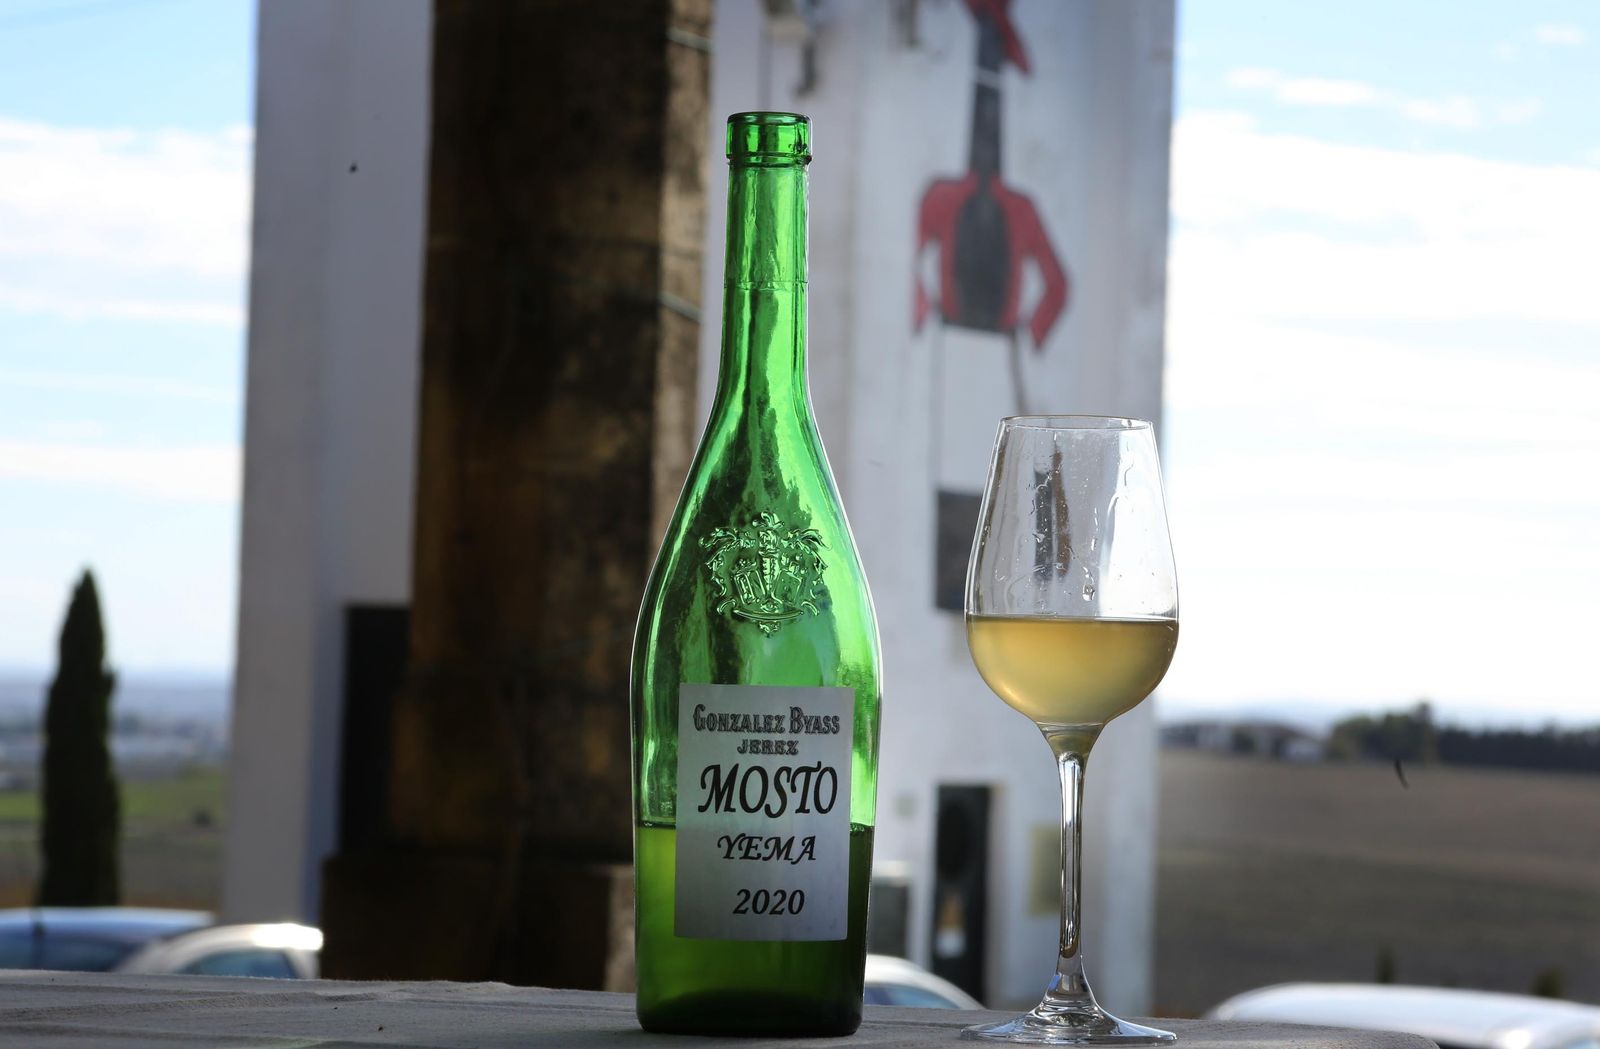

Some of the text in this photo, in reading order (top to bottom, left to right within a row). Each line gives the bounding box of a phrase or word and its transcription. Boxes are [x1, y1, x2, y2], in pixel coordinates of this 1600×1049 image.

[693, 703, 840, 734] GONZALEZ BYASS
[737, 739, 799, 755] JEREZ
[697, 761, 838, 819] MOSTO
[717, 833, 816, 865] YEMA
[733, 889, 805, 915] 2020
